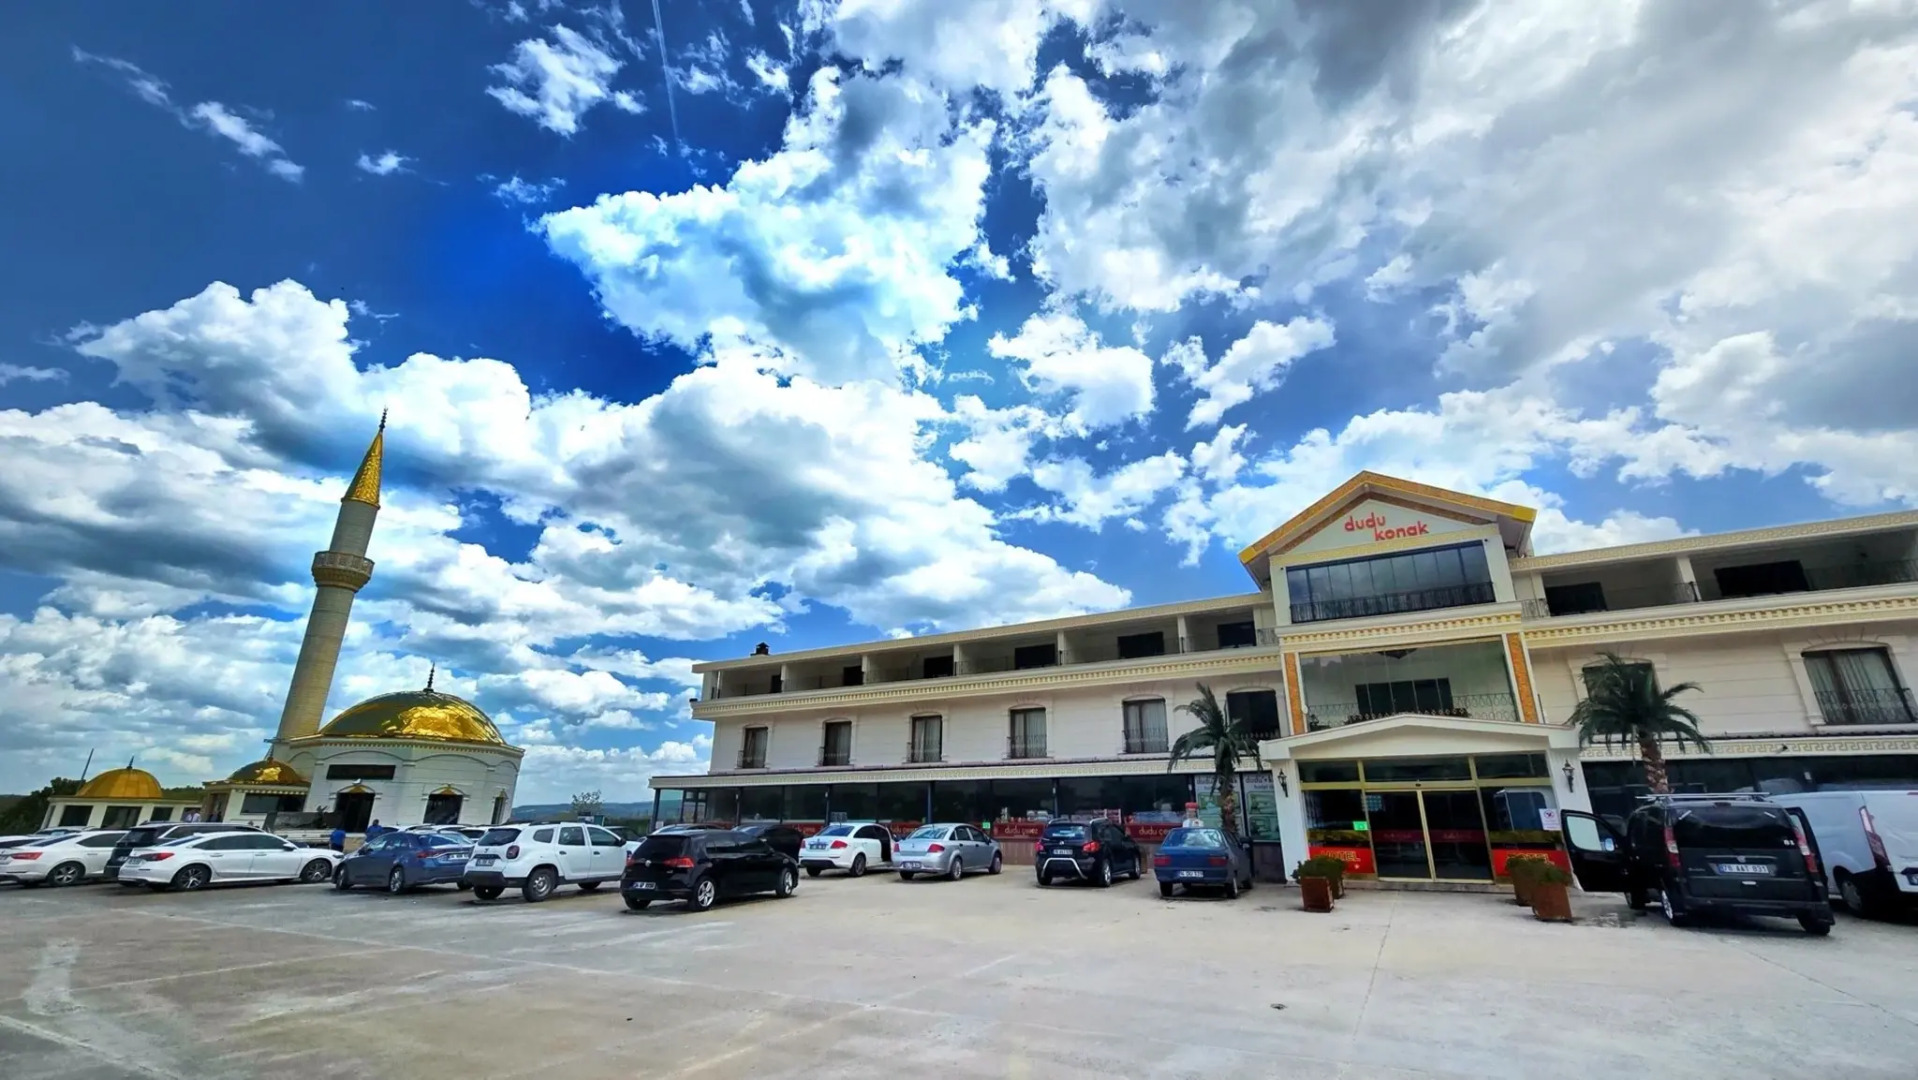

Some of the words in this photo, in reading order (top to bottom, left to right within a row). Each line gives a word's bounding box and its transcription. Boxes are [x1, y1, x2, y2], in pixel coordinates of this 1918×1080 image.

[1344, 511, 1386, 531] dudu
[1374, 520, 1429, 541] konak
[1139, 825, 1157, 835] dudu
